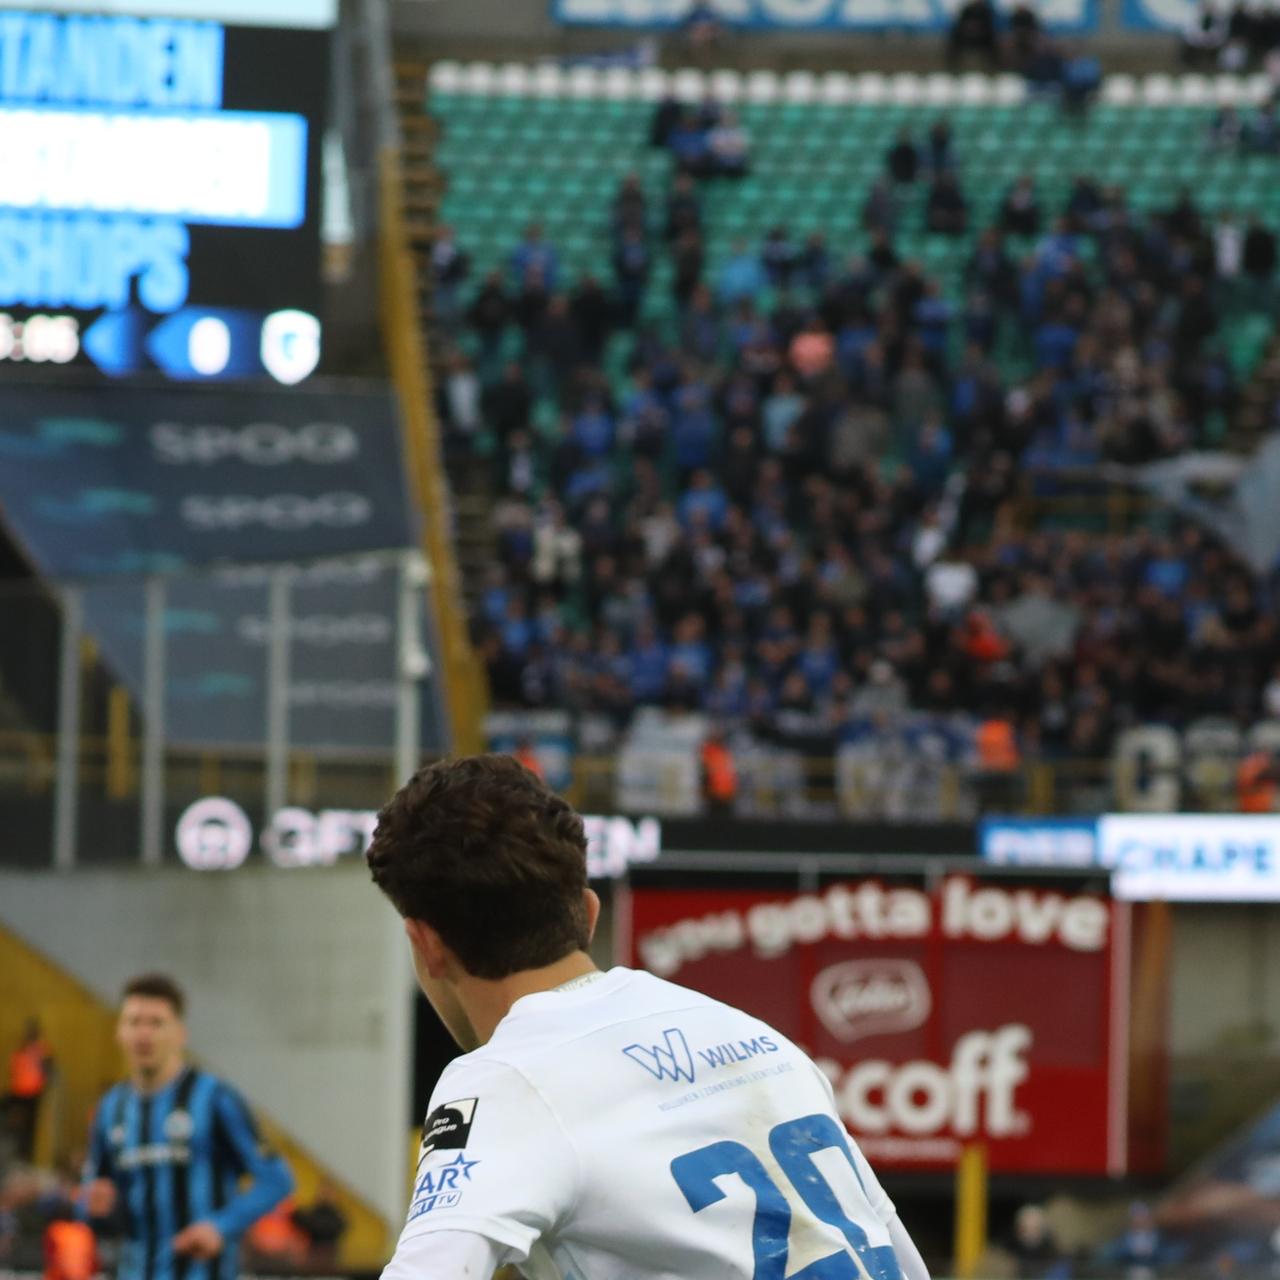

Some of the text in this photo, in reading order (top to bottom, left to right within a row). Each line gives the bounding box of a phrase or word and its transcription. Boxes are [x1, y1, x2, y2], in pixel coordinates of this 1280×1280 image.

[747, 880, 930, 957] gotta
[942, 877, 1109, 951] love
[698, 1036, 779, 1068] WILMS
